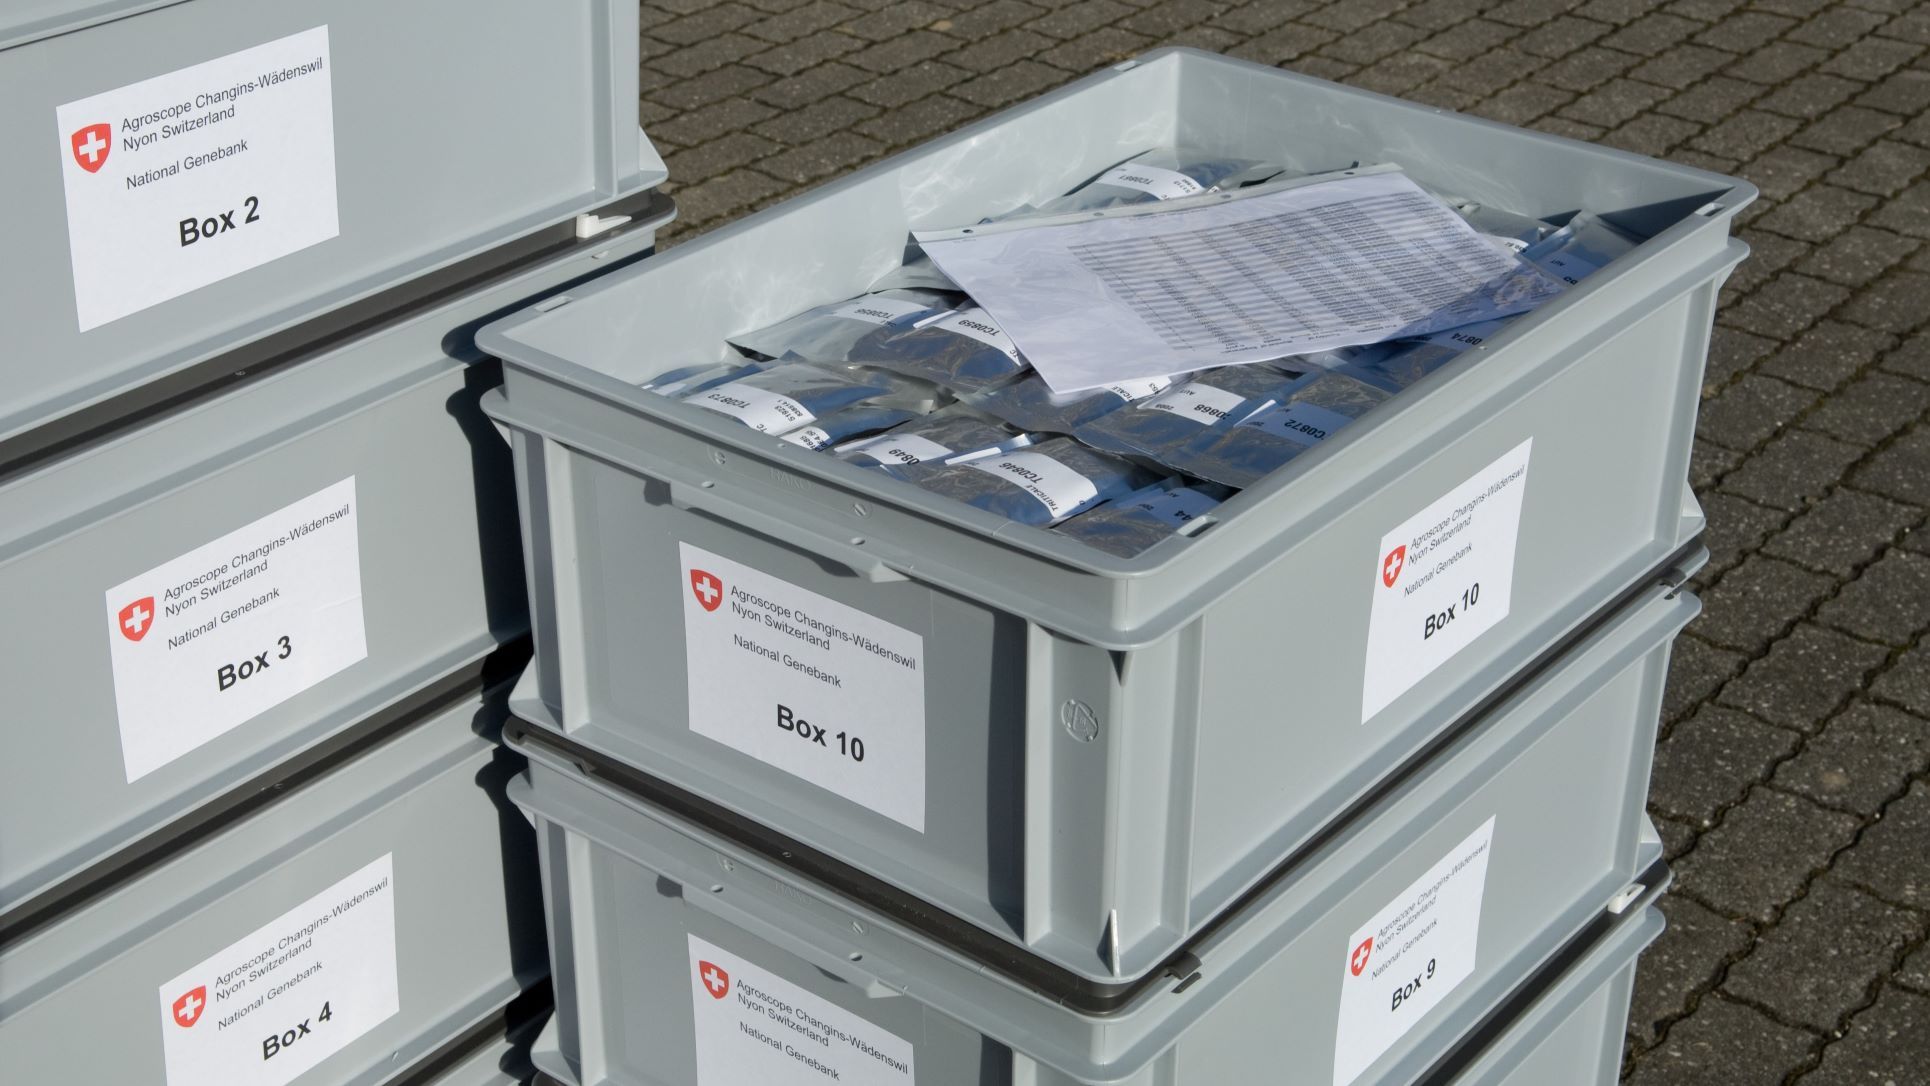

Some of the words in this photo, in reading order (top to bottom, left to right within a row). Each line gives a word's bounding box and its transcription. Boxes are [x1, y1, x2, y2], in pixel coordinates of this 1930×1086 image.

[122, 102, 192, 132] Agroscope
[196, 57, 323, 108] Changins-Wädenswil
[123, 131, 158, 152] Nyon
[162, 105, 235, 139] Switzerland
[126, 161, 179, 190] National
[184, 139, 248, 170] Genebank
[179, 209, 236, 247] Box
[244, 196, 260, 223] 2
[958, 319, 1001, 337] TC0859
[707, 394, 750, 408] TC0873
[999, 462, 1043, 484] TC0846
[1026, 484, 1058, 512] TRITICALE
[164, 563, 228, 601] Agroscope
[232, 504, 350, 568] Changins-Wädenswil
[1408, 545, 1428, 566] Nyon
[1430, 515, 1472, 551] Switzerland
[1410, 516, 1450, 550] Agroscope
[165, 596, 197, 618] Nyon
[200, 559, 268, 600] Switzerland
[1404, 568, 1436, 598] National
[1436, 543, 1473, 575] Genebank
[168, 617, 217, 650] National
[220, 586, 280, 624] Genebank
[730, 585, 791, 618] Agroscope
[794, 610, 916, 670] Changins-Wädenswil
[732, 602, 761, 624] Nyon
[764, 614, 830, 650] Switzerland
[1424, 602, 1456, 640] Box
[1462, 582, 1480, 611] 10
[217, 650, 270, 692] Box
[277, 635, 292, 660] 3
[734, 634, 780, 662] National
[782, 654, 842, 688] Genebank
[777, 704, 827, 746] Box
[836, 731, 865, 762] 10
[215, 946, 275, 988] Agroscope
[278, 876, 388, 950] Changins-Wädenswil
[216, 979, 246, 1002] Nyon
[249, 938, 312, 982] Switzerland
[218, 996, 264, 1031] National
[267, 960, 323, 1000] Genebank
[1391, 971, 1422, 1012] Box
[1426, 958, 1436, 980] 9
[262, 1018, 312, 1062] Box
[318, 1001, 333, 1024] 4
[736, 979, 792, 1014] Agroscope
[796, 1008, 908, 1074] Changins-Wädenswil
[738, 992, 765, 1015] Nyon
[768, 1007, 829, 1047] Switzerland
[740, 1021, 782, 1051] National
[785, 1044, 840, 1081] Genebank
